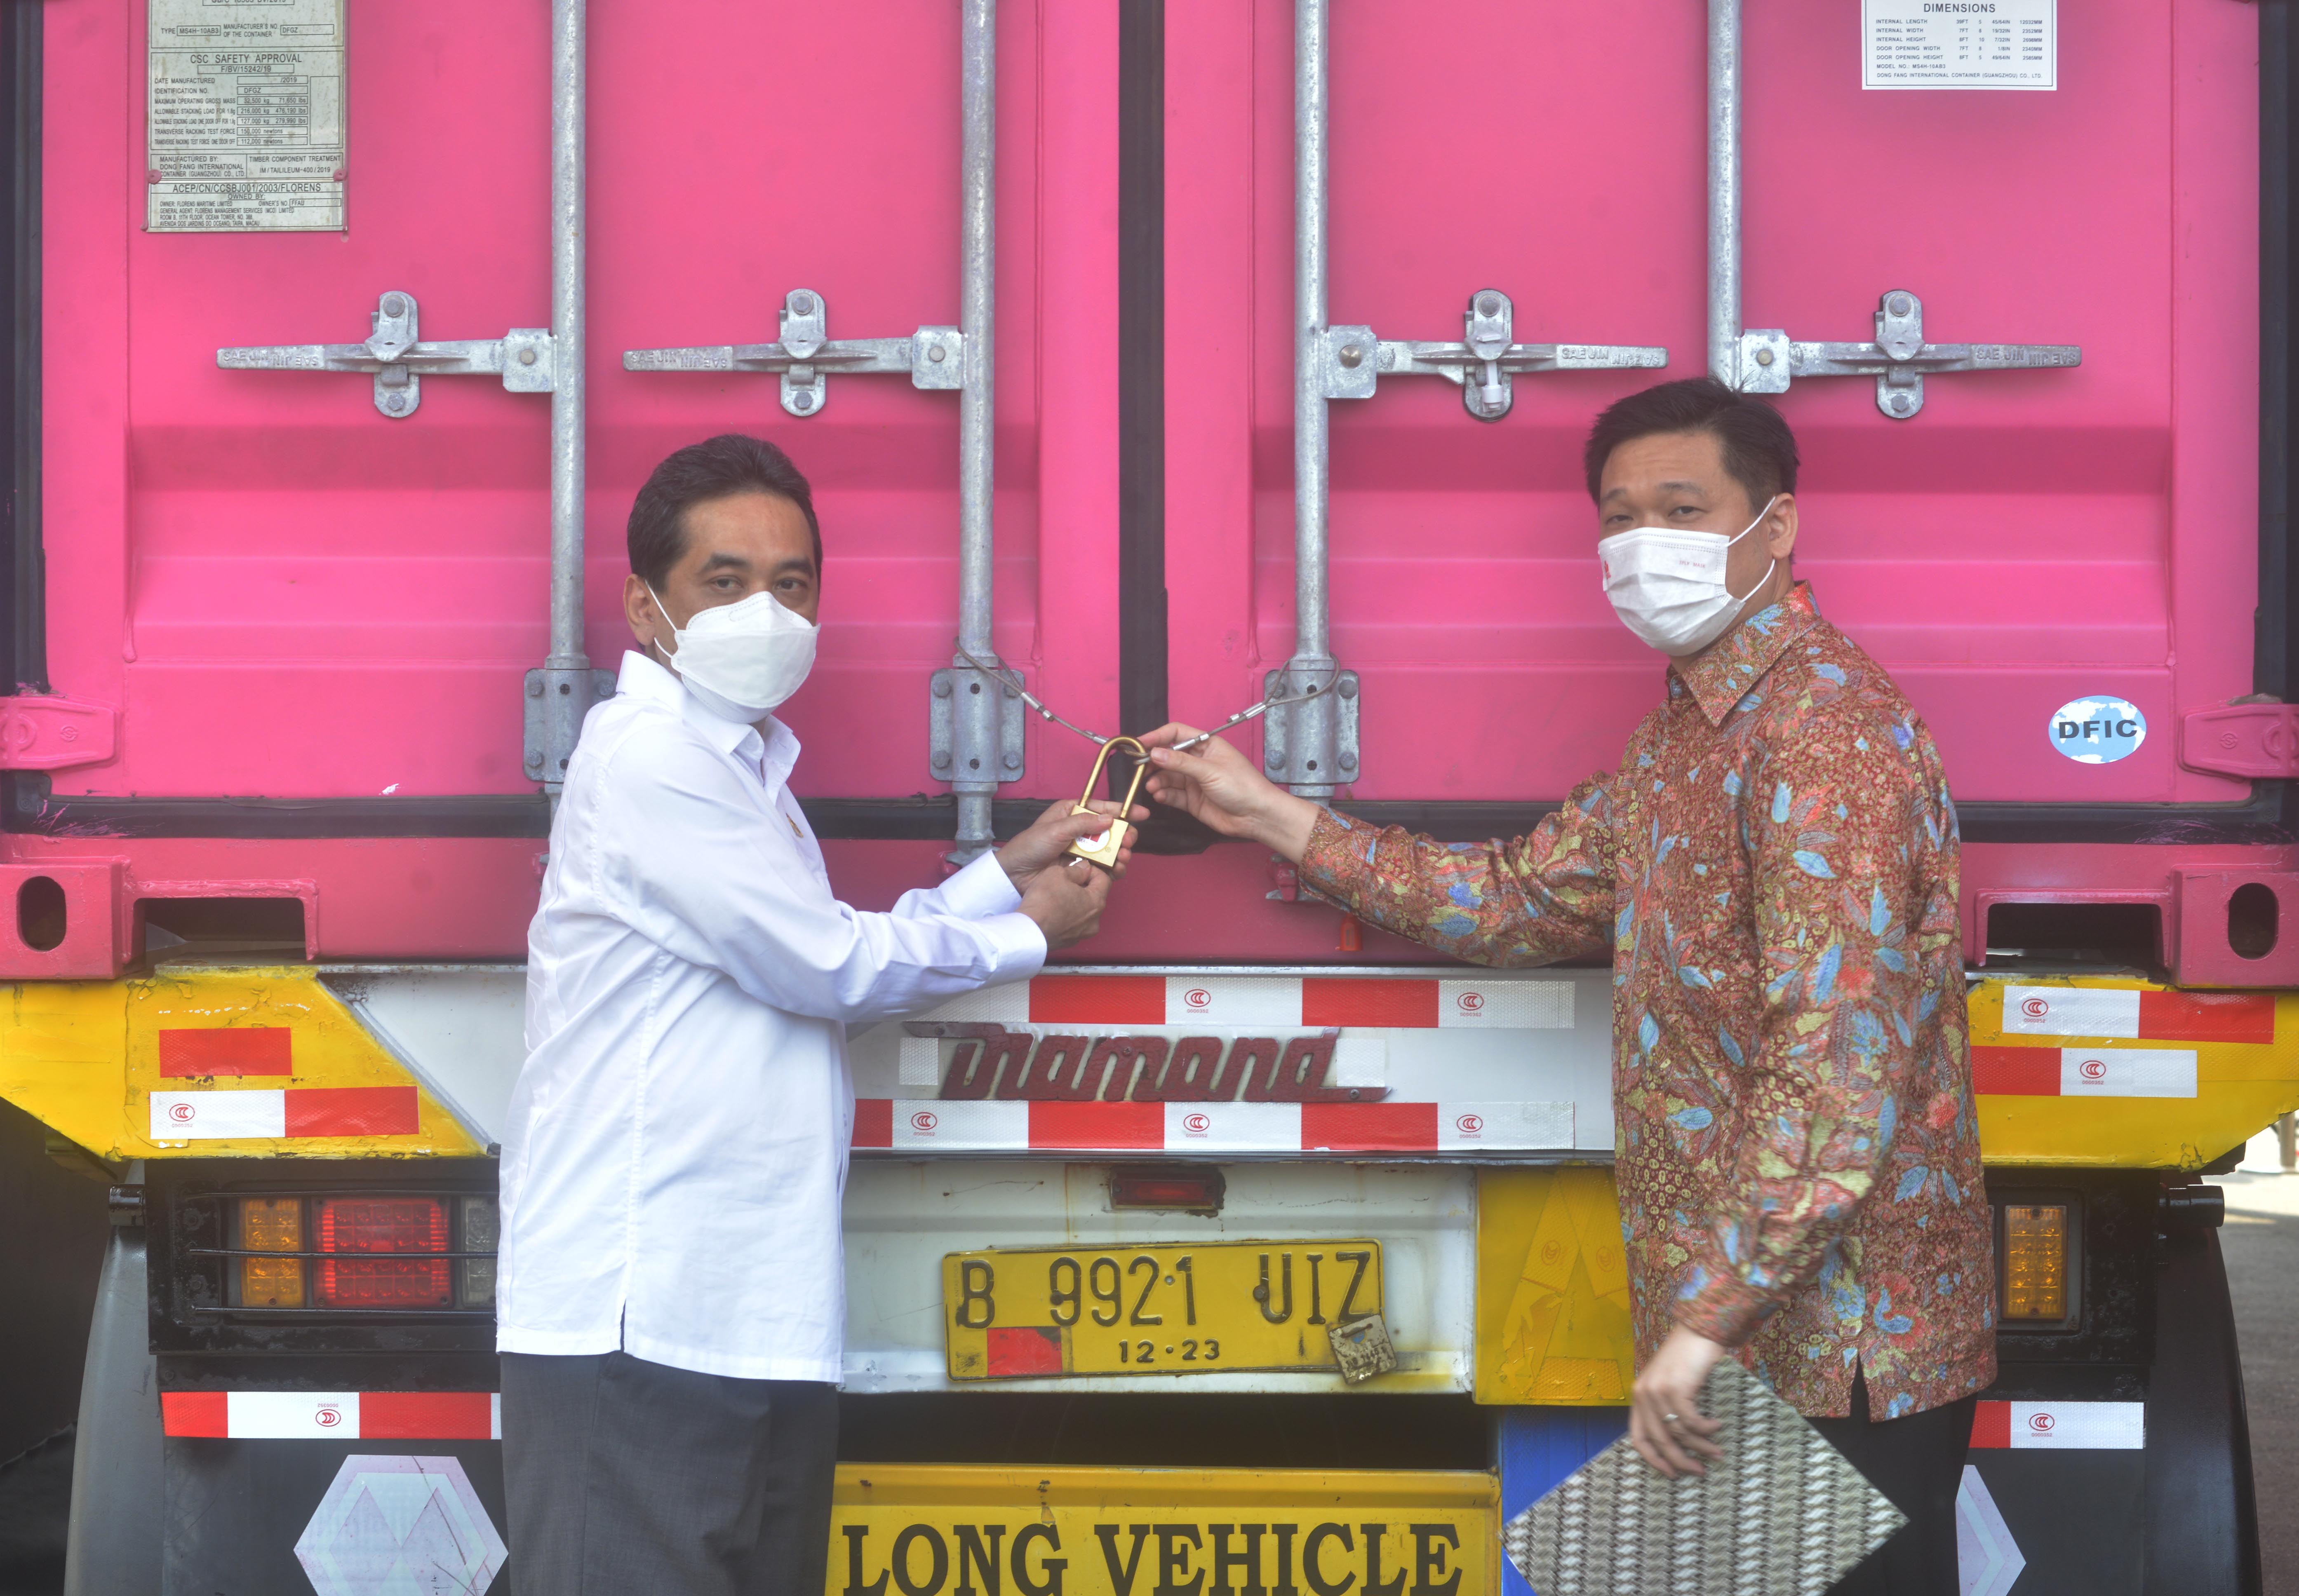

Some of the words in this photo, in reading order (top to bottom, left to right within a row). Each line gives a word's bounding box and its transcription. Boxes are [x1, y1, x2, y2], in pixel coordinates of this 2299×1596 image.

[1924, 3, 1996, 12] DIMENSIONS
[190, 54, 208, 63] CSC
[215, 54, 249, 63] SAFETY
[255, 54, 302, 63] APPROVAL
[2004, 349, 2024, 360] JIN
[2059, 720, 2137, 739] DFIC
[956, 1260, 995, 1329] B
[1049, 1255, 1197, 1326] 9921
[842, 1523, 1068, 1596] LONG
[1094, 1523, 1463, 1596] VEHICLE
